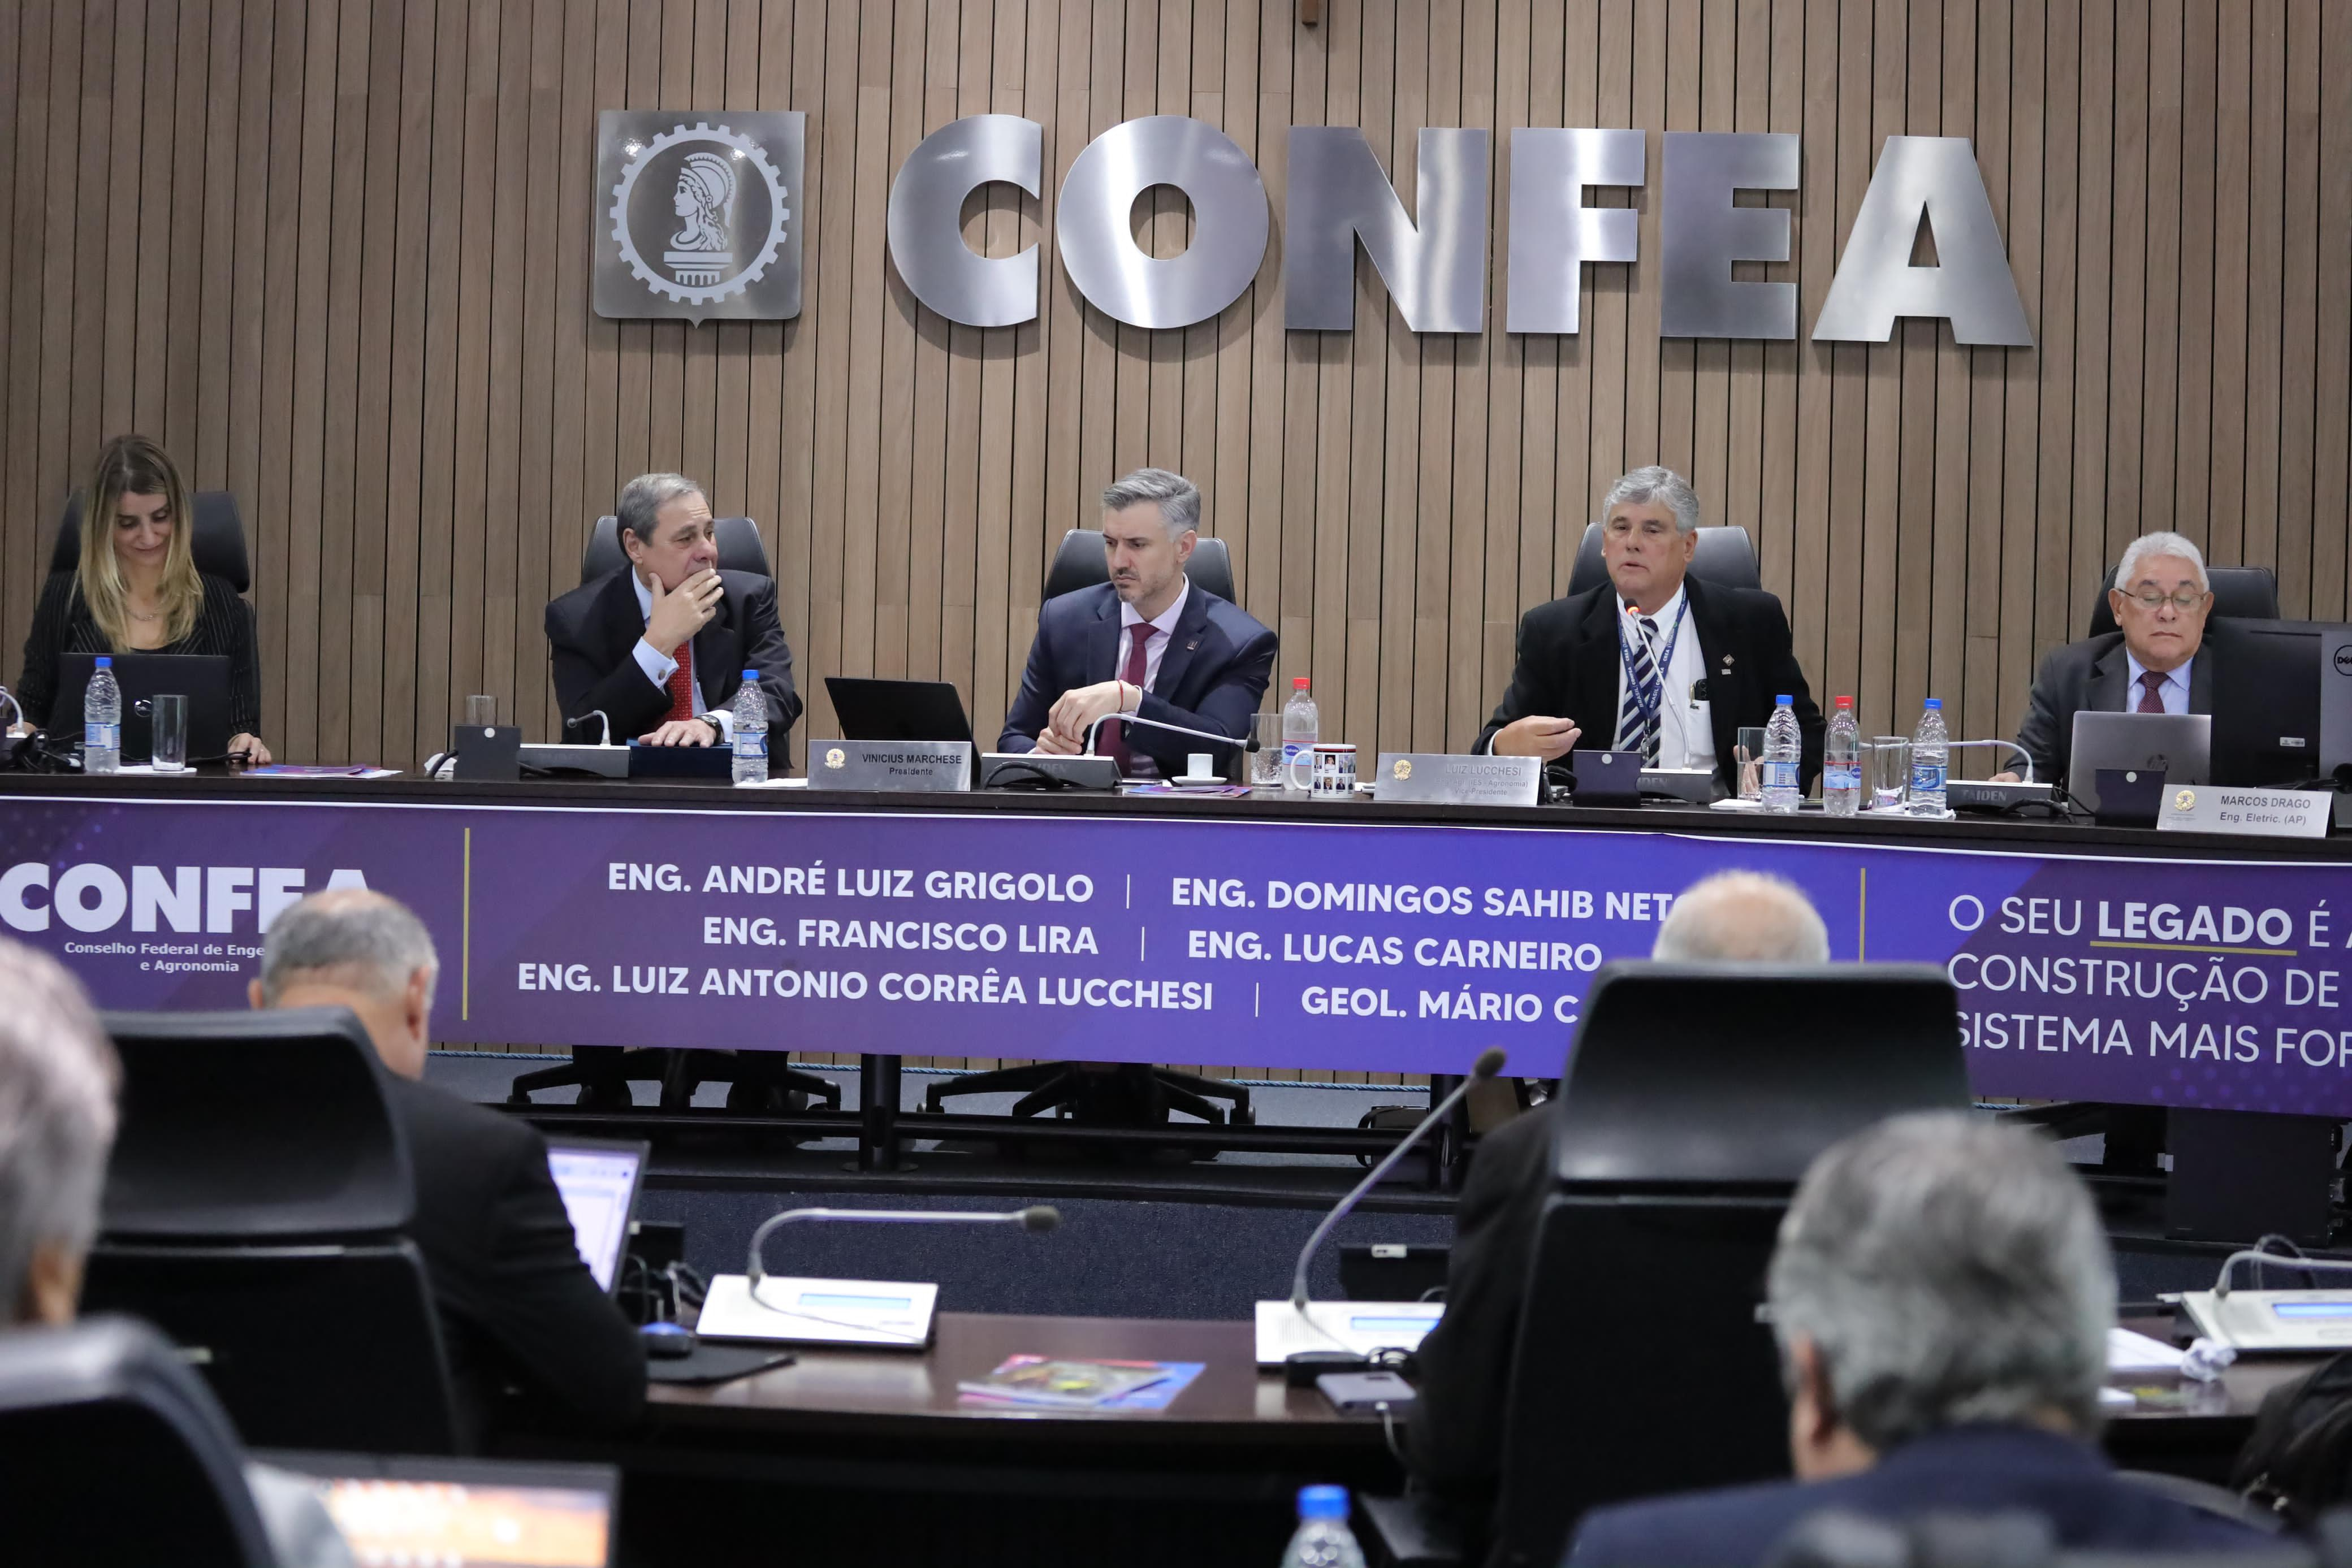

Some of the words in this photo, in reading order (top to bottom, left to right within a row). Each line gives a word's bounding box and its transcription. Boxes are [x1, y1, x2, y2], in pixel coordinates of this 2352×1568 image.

[887, 114, 2034, 346] CONFEA
[1633, 687, 1644, 708] BRASIL
[1649, 688, 1659, 708] BRASIL
[862, 753, 903, 764] VINICIUS
[906, 754, 962, 764] MARCHESE
[1445, 764, 1467, 774] LUIZ
[1470, 766, 1521, 776] LUCCHESI
[1455, 787, 1508, 796] Vice-Presidente
[1488, 779, 1528, 789] Agronomia)
[2220, 795, 2268, 807] MARCOS
[2271, 798, 2311, 809] DRAGO
[2220, 812, 2242, 823] Eng.
[2246, 813, 2280, 823] Eletric.
[2284, 815, 2307, 825] (AP)
[609, 863, 691, 891] ENG.
[703, 860, 825, 895] ANDRÉ
[838, 869, 913, 897] LUIZ
[925, 871, 1093, 902] GRIGOLO
[1173, 878, 1255, 908] ENG.
[1268, 881, 1472, 915] DOMINGOS
[1484, 887, 1593, 918] SAHIB
[1606, 892, 1674, 922] NET
[704, 917, 786, 946] ENG.
[799, 920, 1006, 951] FRANCISCO
[1019, 925, 1099, 954] LIRA
[1949, 895, 1984, 931] O
[2000, 896, 2081, 935] SEU
[2099, 901, 2292, 947] LEGADO
[2309, 899, 2330, 947] É
[64, 942, 136, 954] Conselho
[141, 943, 198, 955] Federal
[204, 943, 223, 955] de
[1189, 930, 1271, 960] ENG.
[1284, 934, 1403, 965] LUCAS
[1415, 938, 1602, 972] CARNEIRO
[140, 962, 149, 971] e
[154, 960, 239, 974] Agronomia
[519, 963, 600, 991] ENG.
[613, 966, 688, 994] LUIZ
[700, 969, 867, 999] ANTONIO
[879, 968, 1027, 1003] CORRÊA
[1039, 977, 1212, 1010] LUCCHESI
[1948, 953, 2268, 1011] CONSTRUÇÃO
[2286, 969, 2339, 1007] DE
[1302, 986, 1407, 1017] GEOL.
[1419, 984, 1542, 1022] MÁRIO
[1957, 1011, 2133, 1055] SISTEMA
[2150, 1021, 2259, 1062] MAIS
